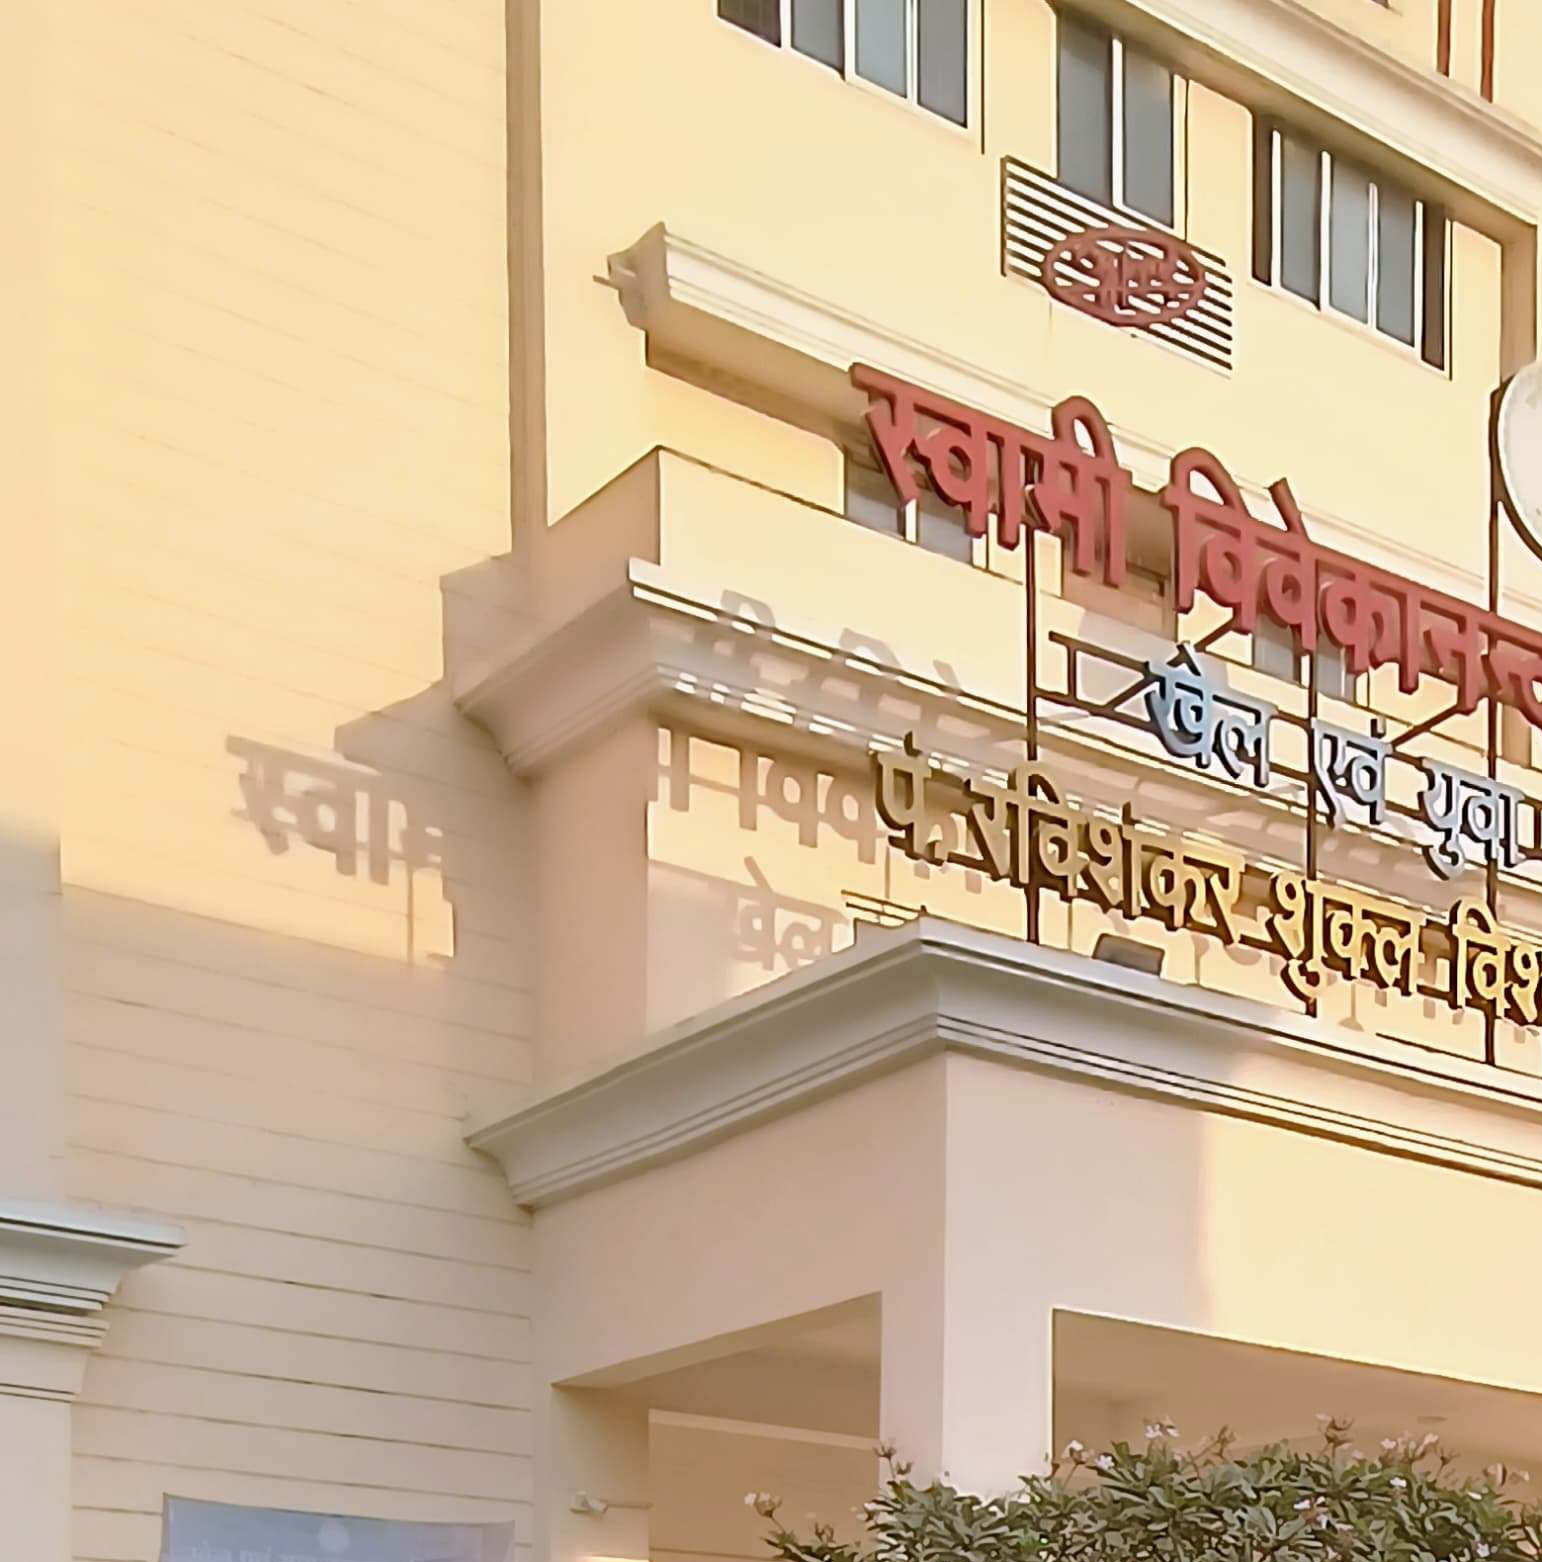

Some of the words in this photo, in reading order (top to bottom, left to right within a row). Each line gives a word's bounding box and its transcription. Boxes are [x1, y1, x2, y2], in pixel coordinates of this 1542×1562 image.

[849, 362, 1132, 588] स्वामी
[963, 760, 1246, 946] रविशंकर
[1268, 871, 1427, 1000] शुक्ल
[1144, 642, 1277, 787] खेल
[1308, 718, 1393, 829] एवं
[1416, 758, 1526, 882] युवा
